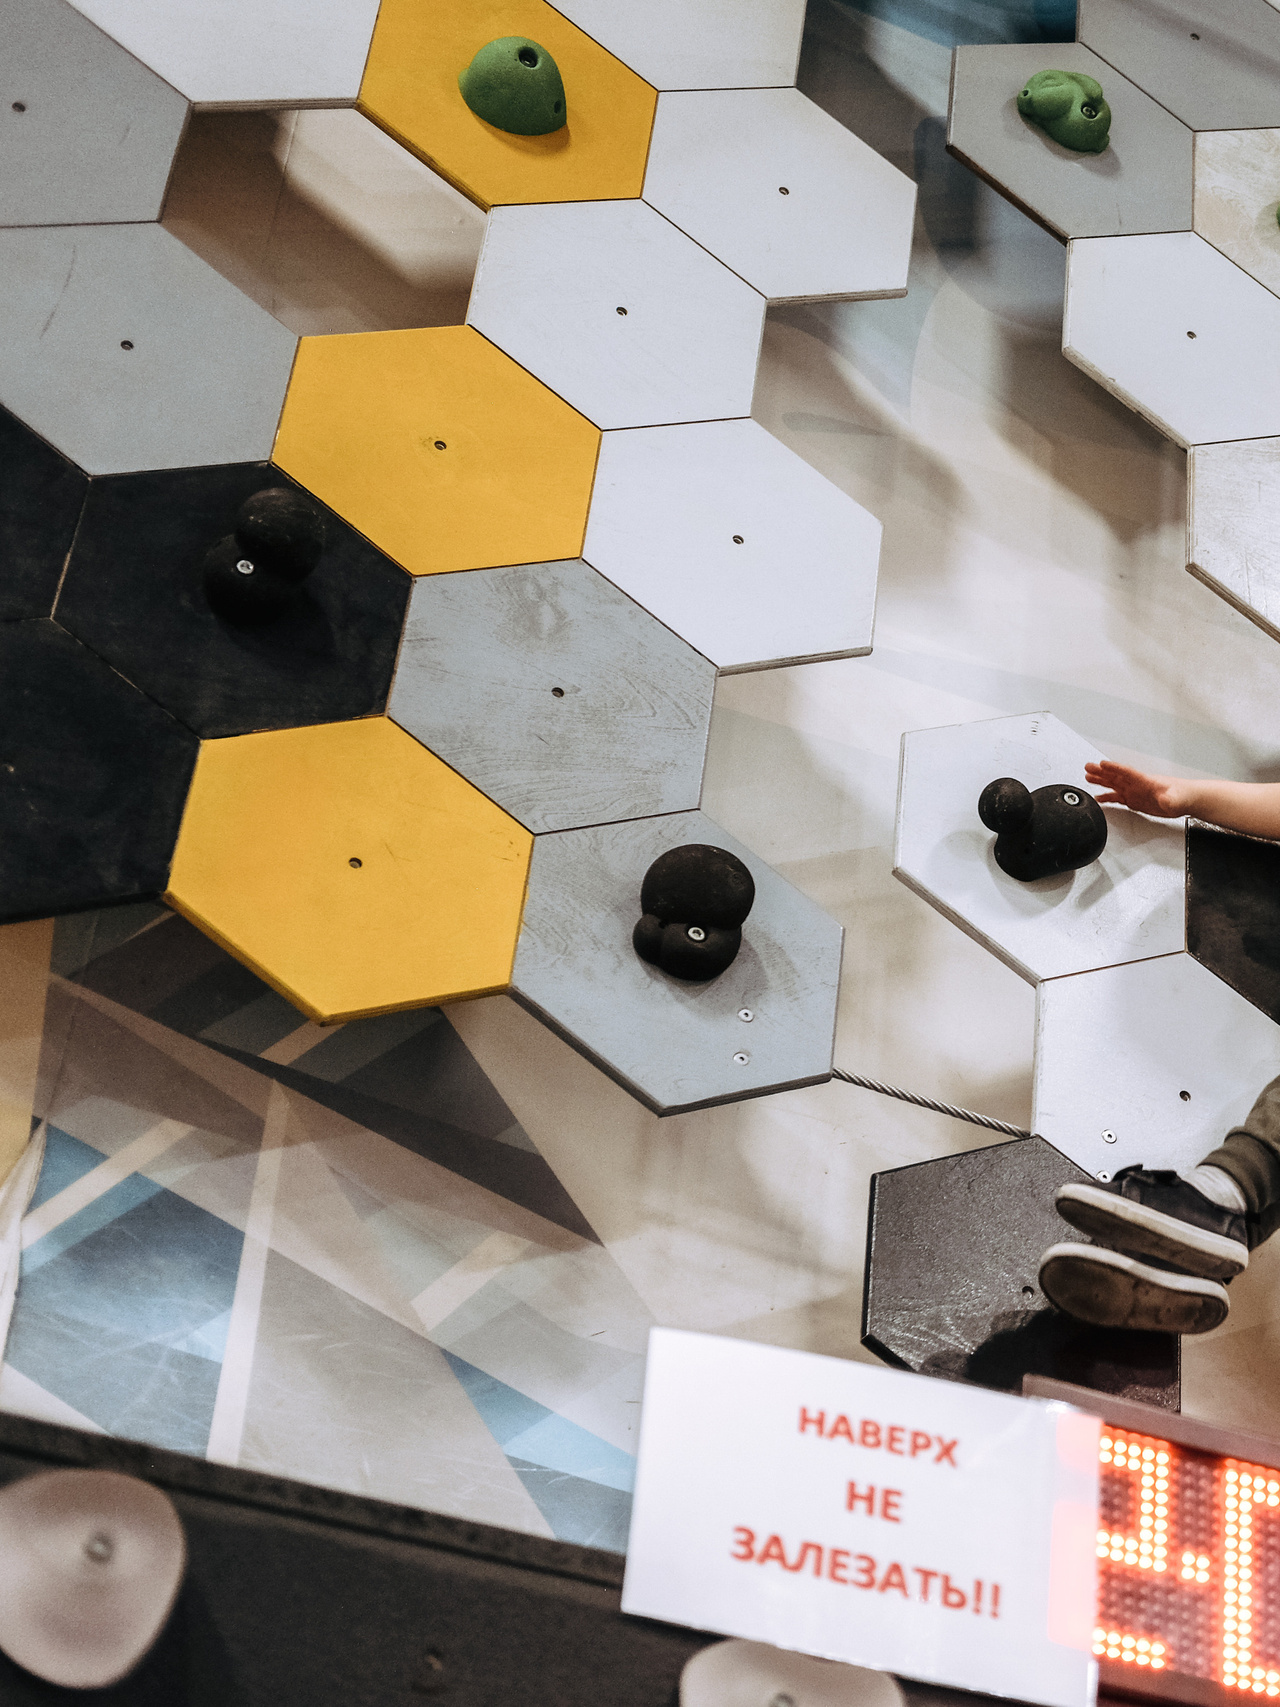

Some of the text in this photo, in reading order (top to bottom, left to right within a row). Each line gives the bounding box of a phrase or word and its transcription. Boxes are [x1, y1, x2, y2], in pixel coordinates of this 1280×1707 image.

[798, 1406, 960, 1468] НАВЕРХ
[845, 1480, 904, 1524] НЕ
[731, 1526, 1002, 1619] ЗАЛЕЗАТЬ!!
